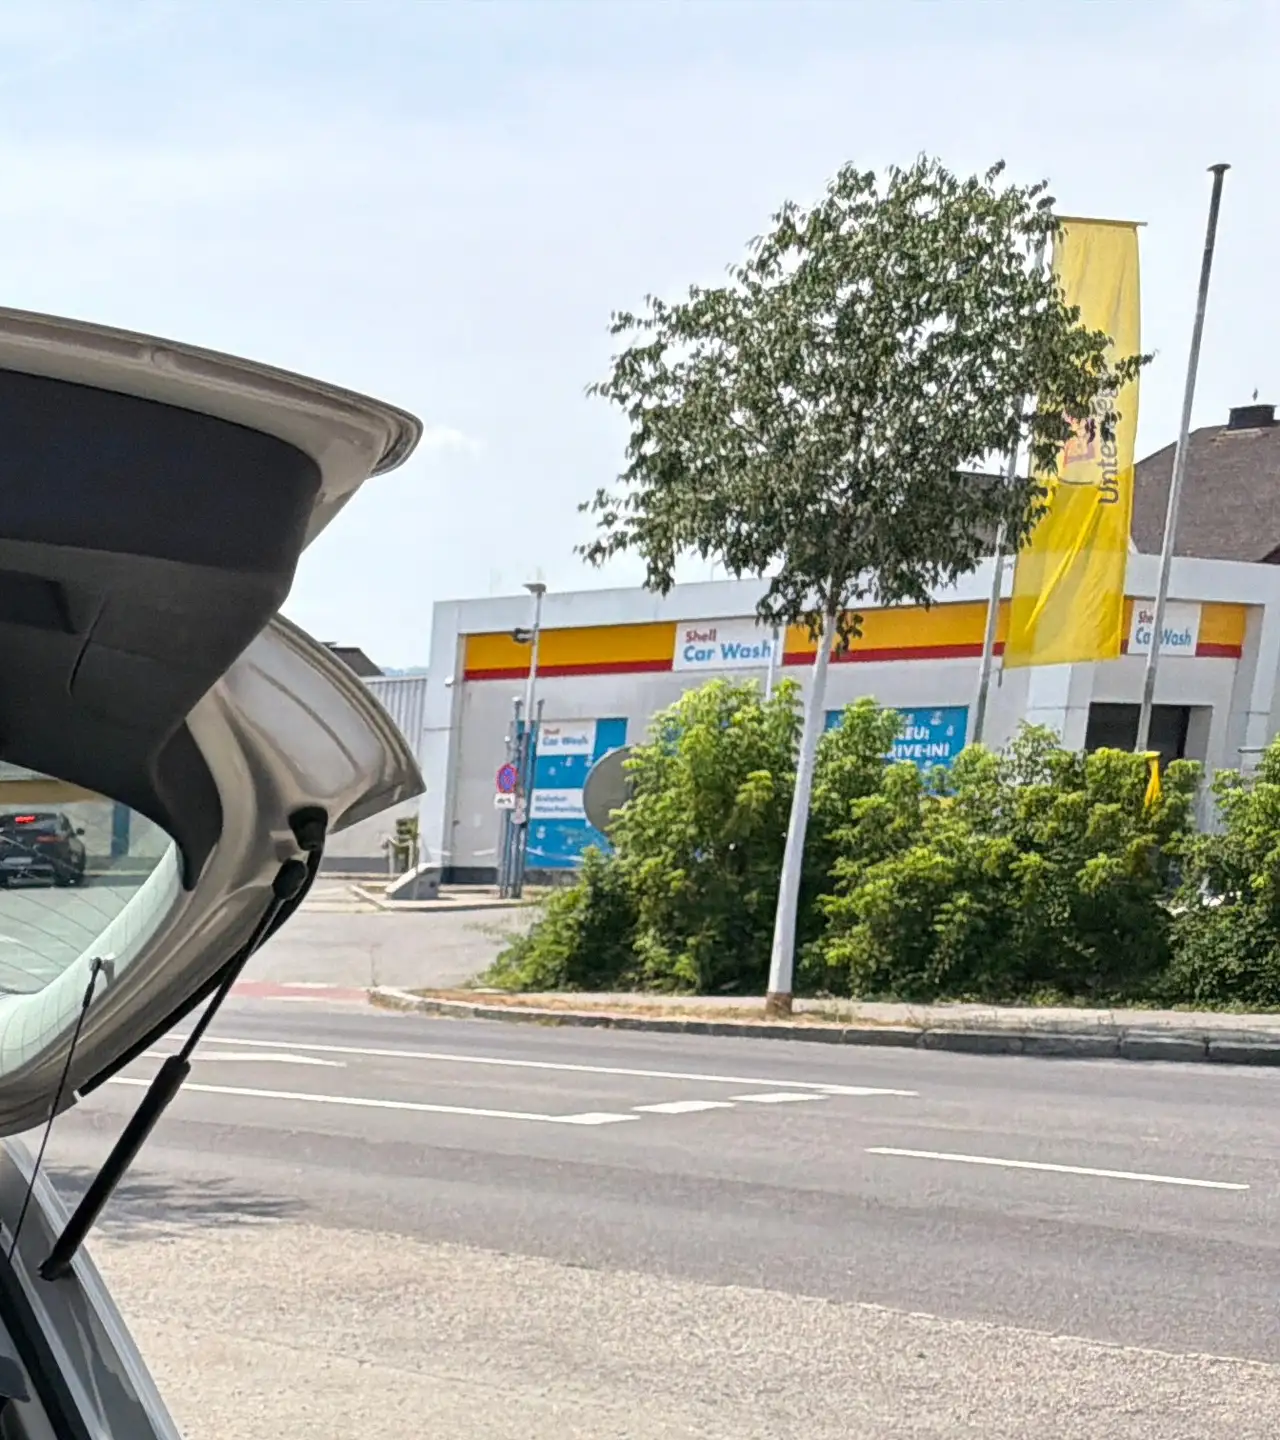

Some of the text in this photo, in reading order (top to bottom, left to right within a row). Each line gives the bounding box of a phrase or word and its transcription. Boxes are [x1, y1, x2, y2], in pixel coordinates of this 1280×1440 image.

[686, 628, 717, 643] Shell
[1135, 627, 1152, 645] Ca
[683, 639, 772, 662] Car Wash
